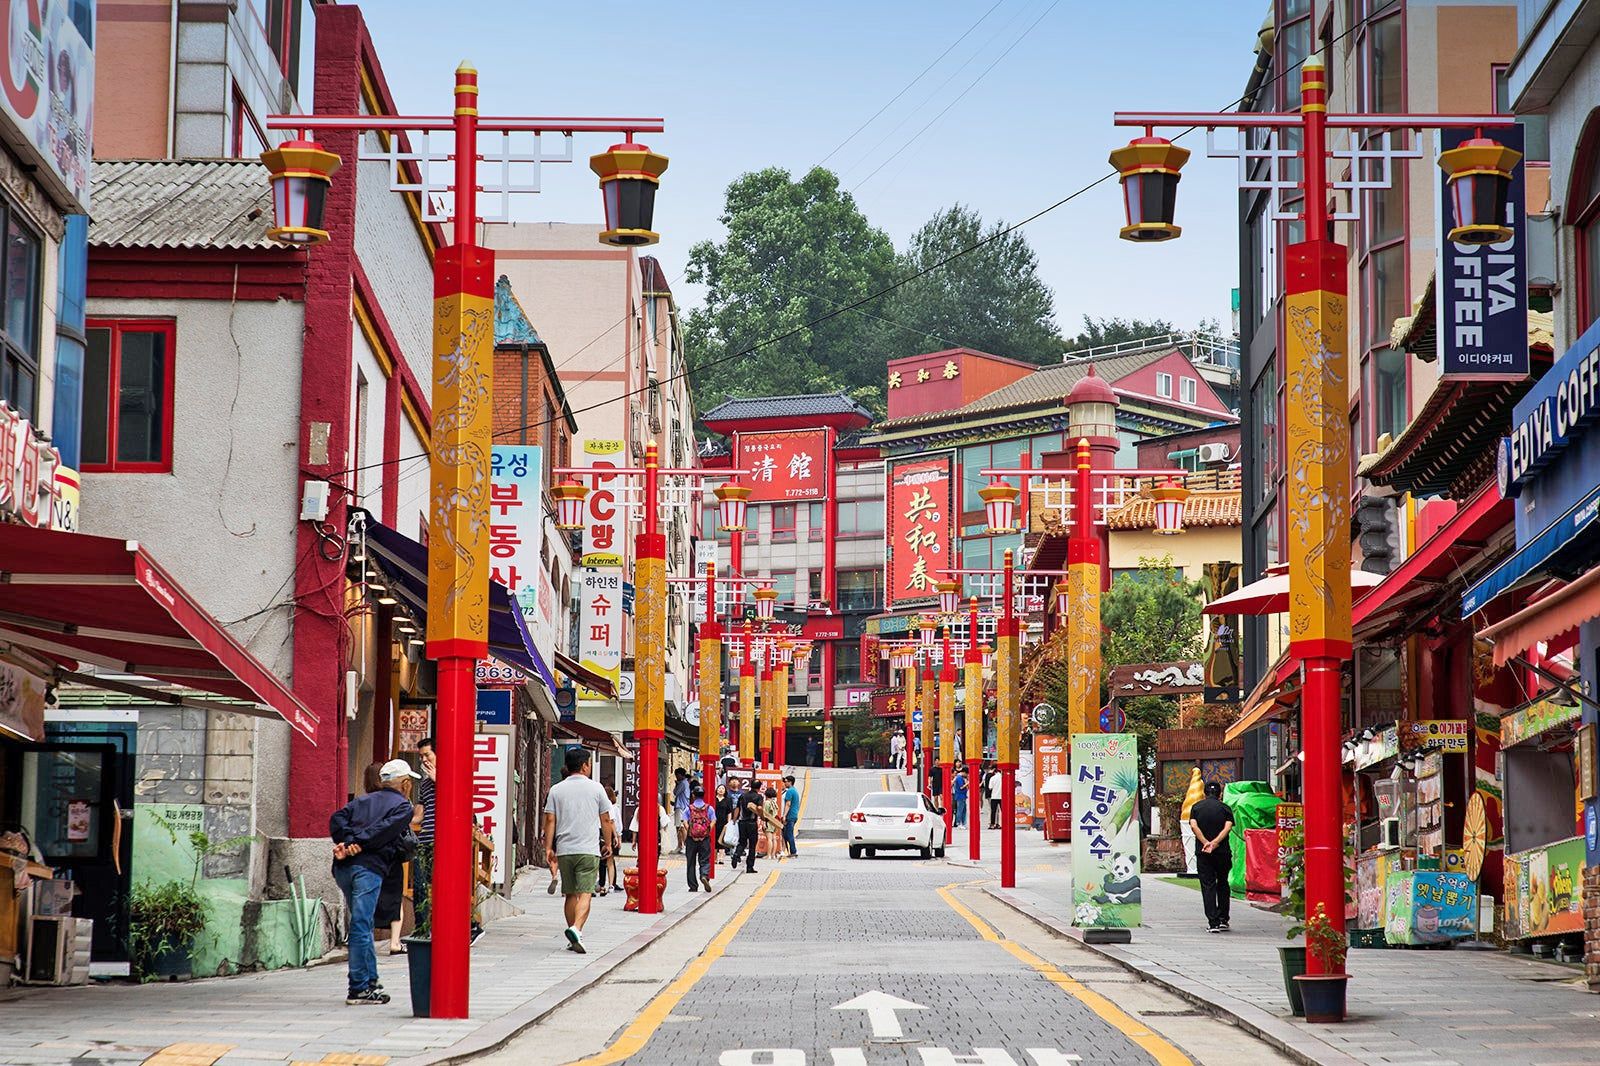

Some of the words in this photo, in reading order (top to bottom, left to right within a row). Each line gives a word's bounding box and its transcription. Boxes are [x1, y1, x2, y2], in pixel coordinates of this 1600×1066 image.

[1458, 353, 1513, 365] 이디야커피
[888, 360, 959, 389] 共和春
[1511, 397, 1553, 483] EDIYA
[491, 453, 528, 478] 유성
[751, 452, 812, 482] 清館
[904, 486, 939, 591] 共和春
[587, 556, 619, 565] Internet
[585, 576, 618, 589] 하인천
[590, 594, 612, 648] 슈퍼
[1078, 742, 1100, 750] 100%
